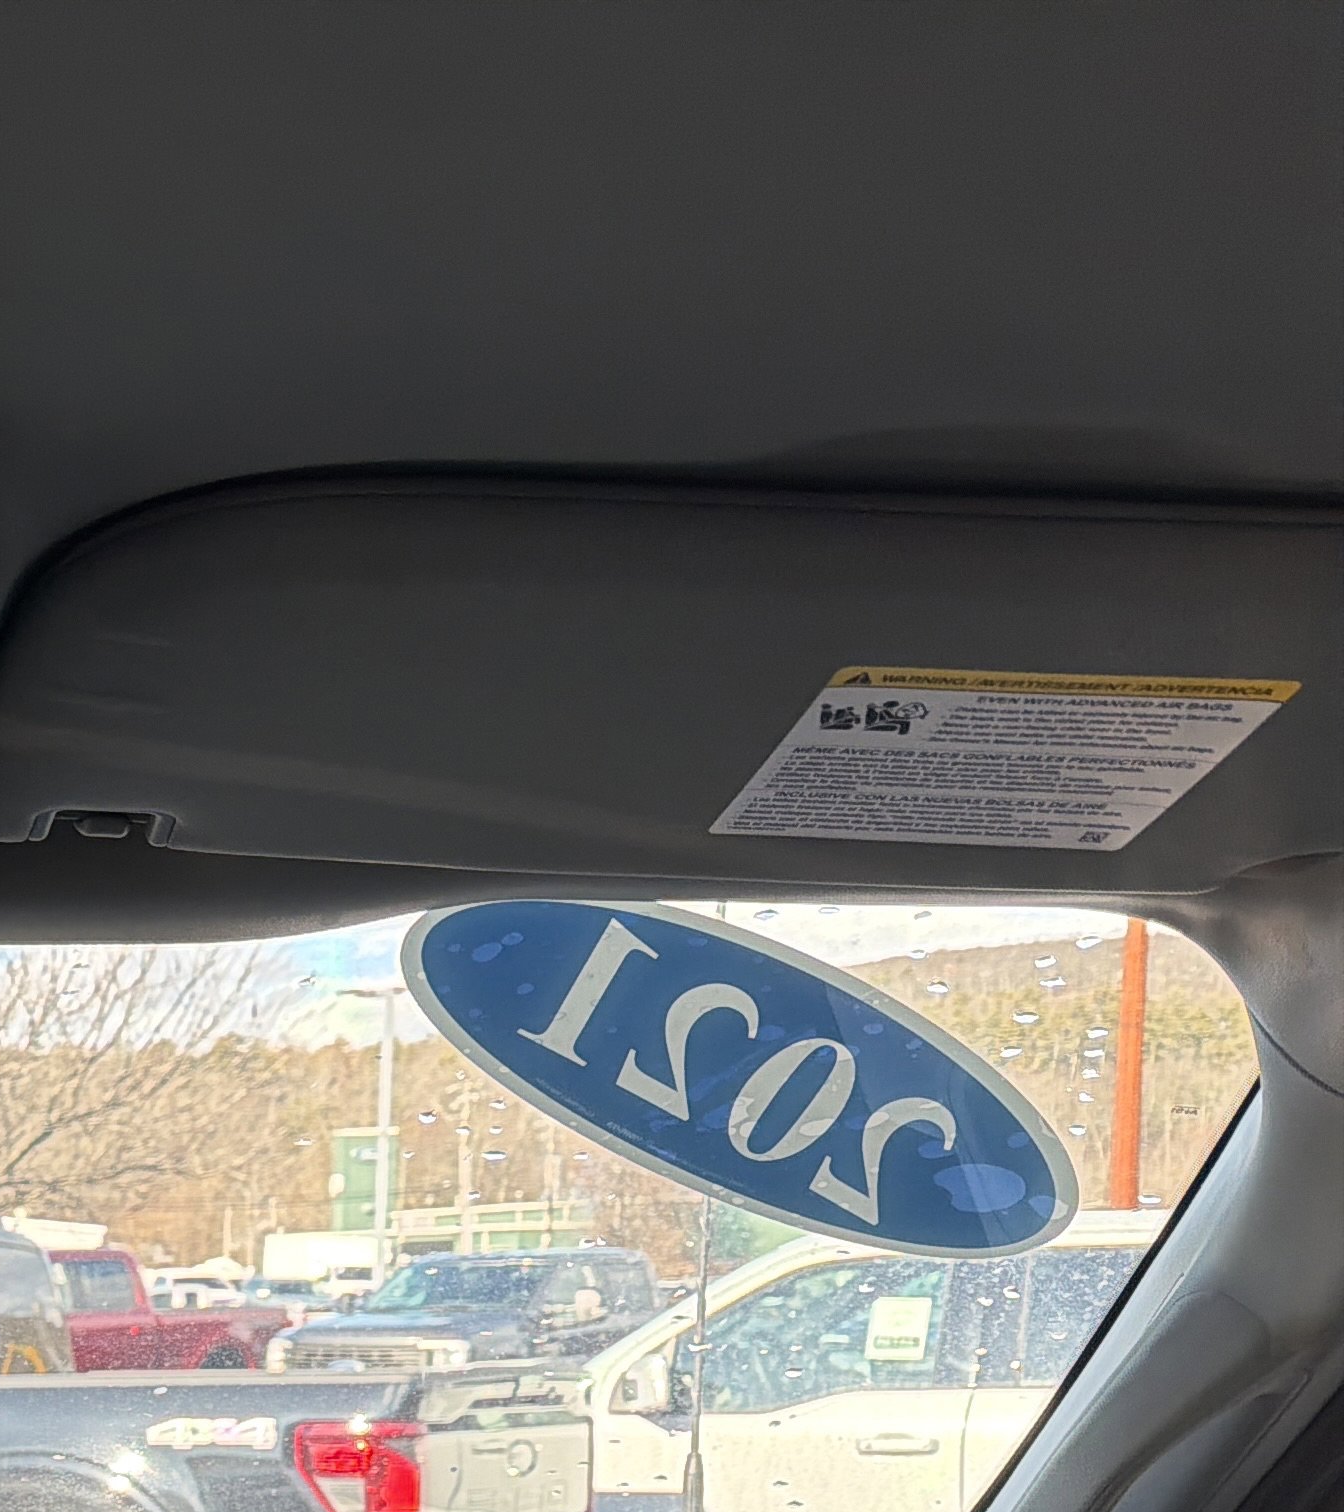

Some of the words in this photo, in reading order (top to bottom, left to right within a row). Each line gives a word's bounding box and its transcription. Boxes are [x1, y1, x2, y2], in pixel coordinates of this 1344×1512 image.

[882, 674, 966, 686] WARNING
[977, 695, 1020, 704] EVEN
[1023, 696, 1064, 705] WITH
[1067, 698, 1155, 708] ADVANCED
[1157, 701, 1182, 710] AIR
[1186, 702, 1233, 712] BAGS
[844, 748, 882, 757] AVEC
[884, 750, 914, 758] DES
[917, 751, 962, 760] SACS
[854, 792, 887, 802] CON
